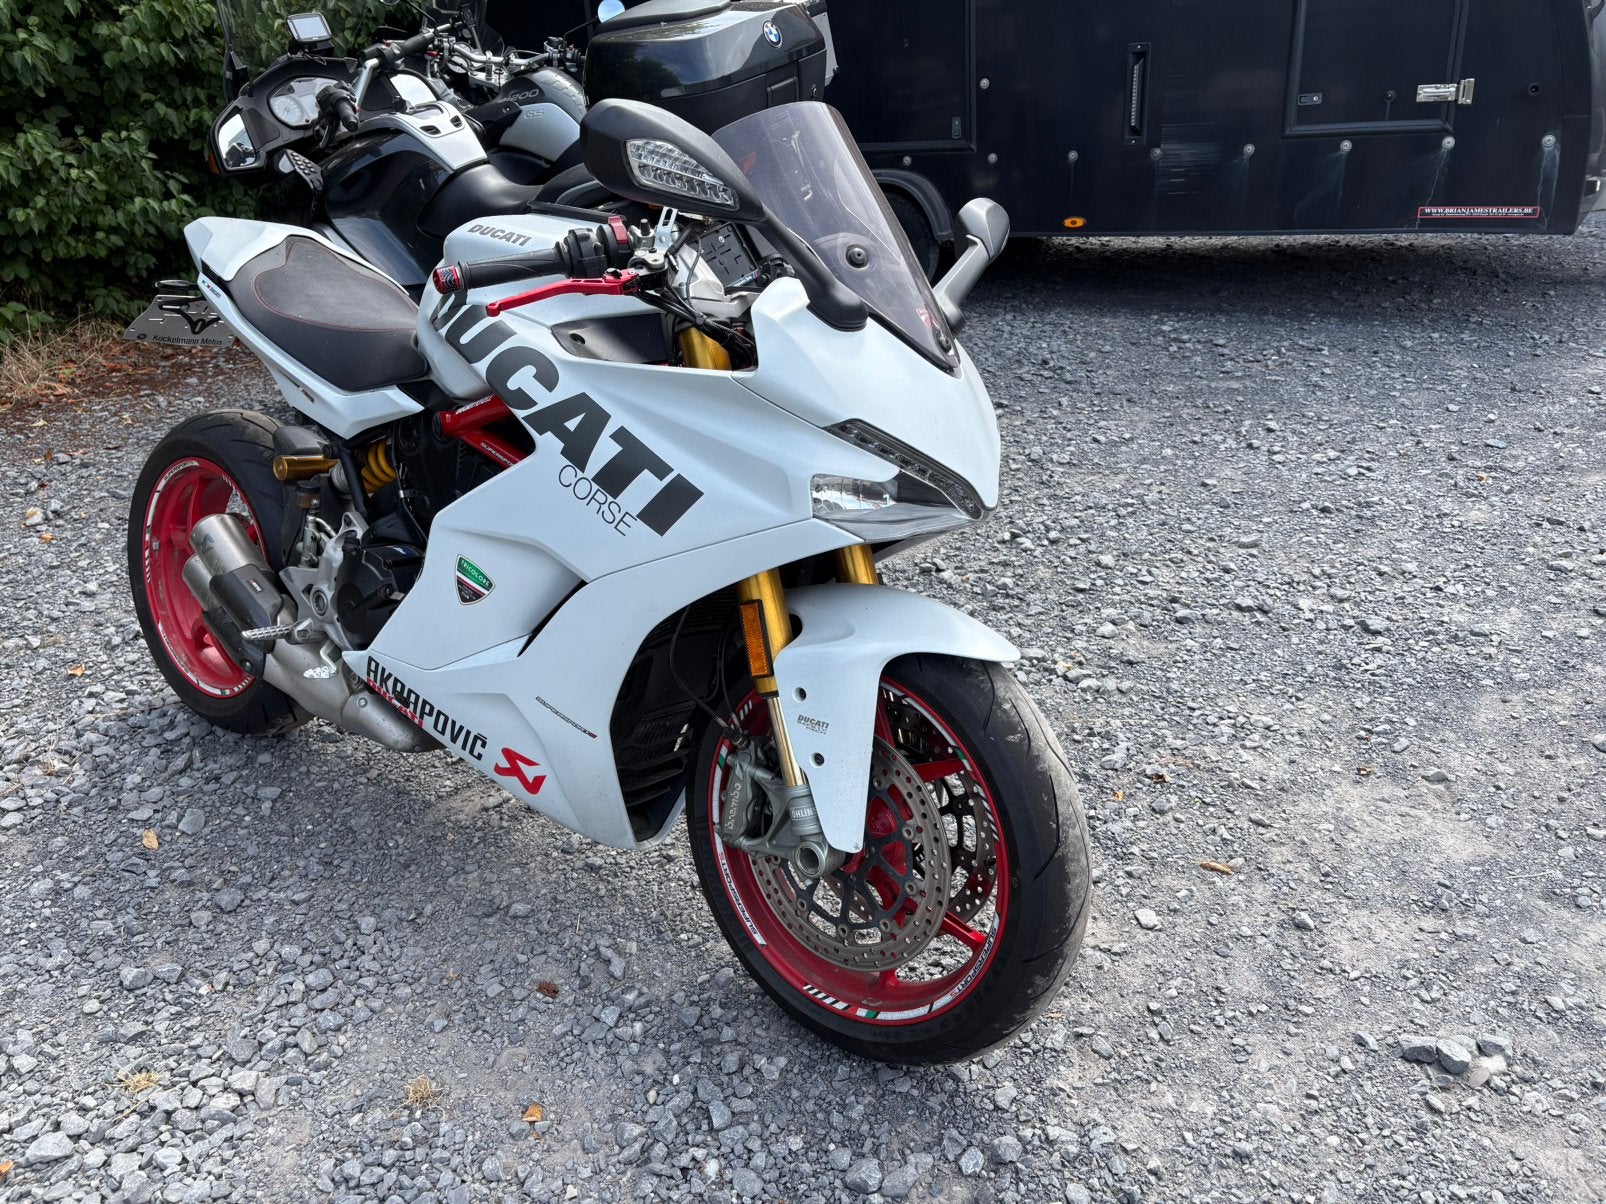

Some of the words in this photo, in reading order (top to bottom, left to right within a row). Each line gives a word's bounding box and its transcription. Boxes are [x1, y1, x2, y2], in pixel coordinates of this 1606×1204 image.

[467, 224, 532, 247] DUCATI
[153, 334, 199, 345] Kockelmann
[200, 338, 223, 346] Motos
[558, 464, 638, 537] CORSE
[461, 559, 491, 587] TRICOLORE
[797, 714, 830, 729] DUCATI
[725, 782, 742, 830] brembo
